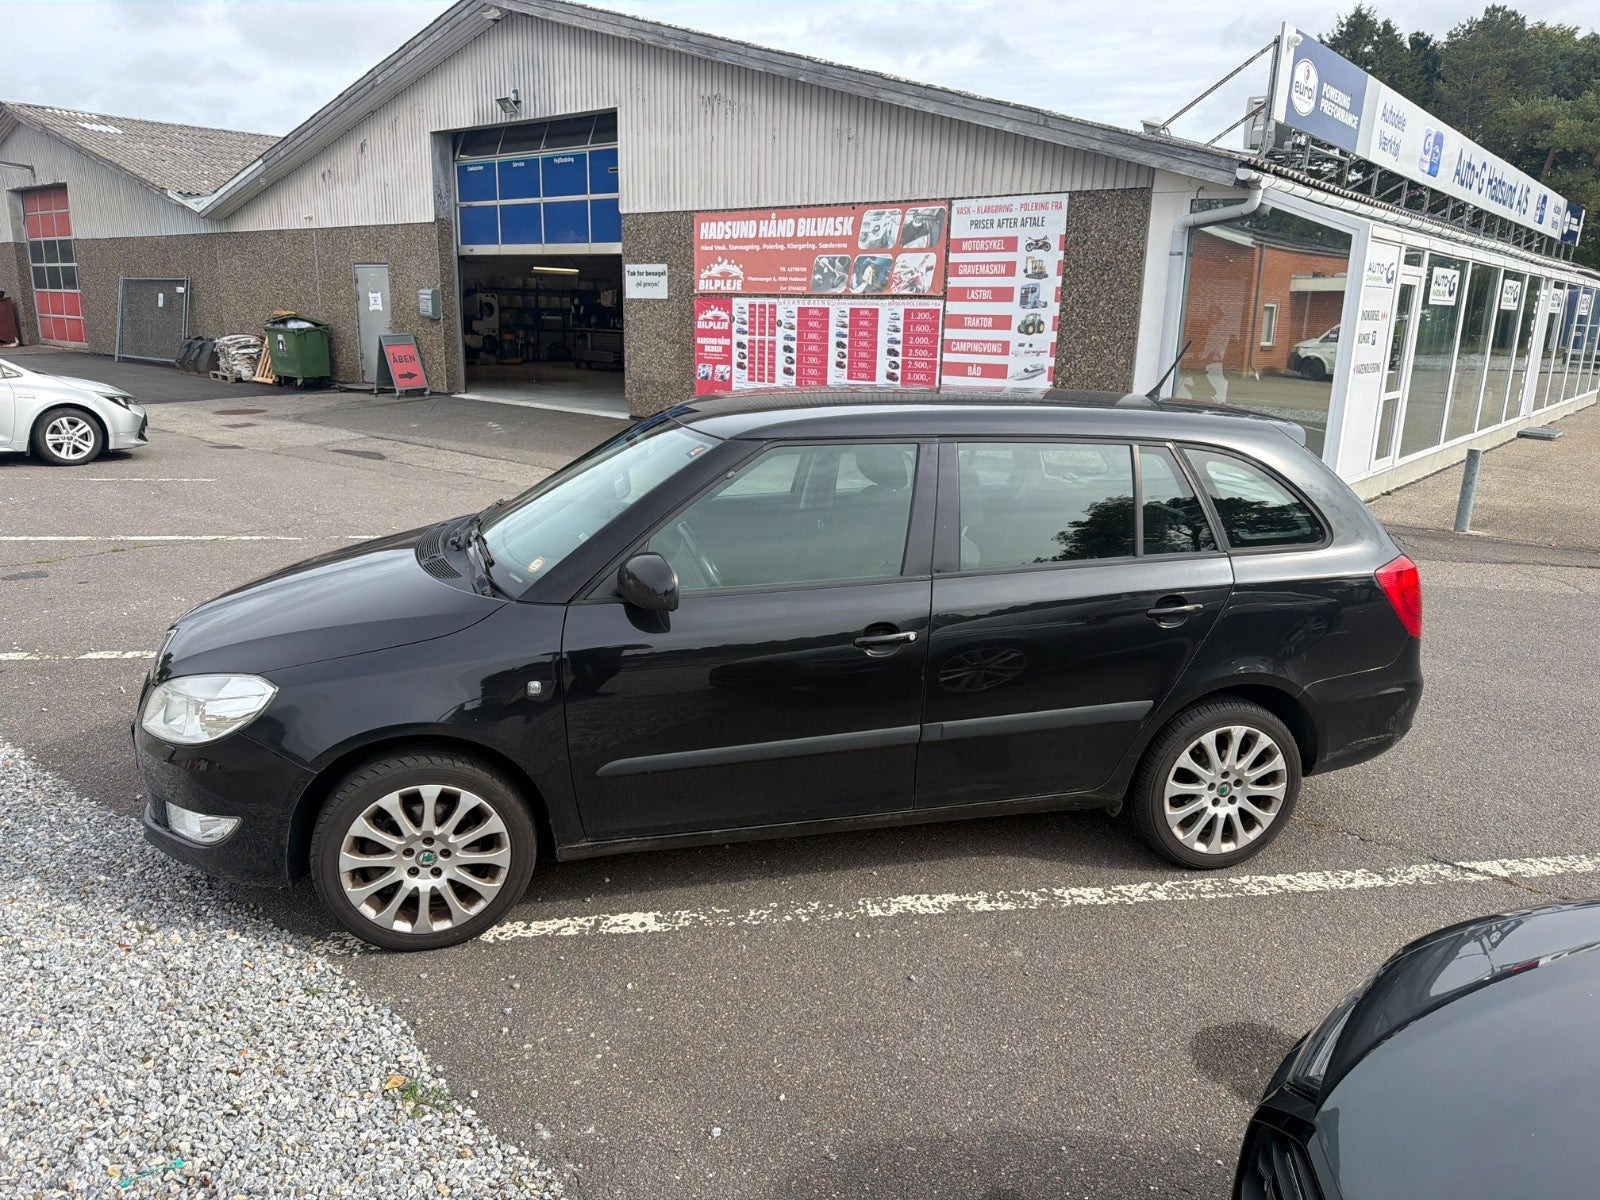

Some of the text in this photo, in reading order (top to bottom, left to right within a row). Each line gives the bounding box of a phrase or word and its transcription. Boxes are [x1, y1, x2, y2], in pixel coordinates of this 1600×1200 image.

[1322, 82, 1351, 110] POWERING
[1381, 102, 1407, 133] Autodele
[1453, 148, 1487, 195] Auto-G
[1485, 165, 1518, 210] Hadsund
[1516, 180, 1531, 217] A/S
[956, 206, 971, 215] VASK
[976, 204, 1013, 214] KLARGØRING
[1020, 202, 1049, 212] POLERING
[1051, 201, 1063, 211] FRA
[700, 212, 855, 240] HADSUND HÅND BILVASK
[970, 216, 1046, 230] PRISER AFTER AFTALE
[962, 239, 1005, 251] MOTORSYKEL
[958, 264, 1006, 275] GRAVEMASKIN
[1368, 261, 1395, 284] AUTO-G
[699, 279, 743, 291] BILPLEJE
[1434, 274, 1456, 298] AUTO-G
[966, 290, 993, 300] LASTBIL
[911, 312, 935, 321] 1.200,-
[963, 317, 993, 328] TRAKTOR
[697, 320, 729, 330] BILPLEJE
[910, 324, 934, 333] 1.600,-
[908, 336, 933, 345] 2.000,-
[908, 348, 933, 357] 2.500,-
[951, 341, 1002, 353] CAMPINGVONG
[392, 352, 416, 364] ÅBEN
[907, 361, 932, 370] 2.500,-
[967, 365, 982, 376] BÅD
[906, 373, 932, 382] 3.000,-
